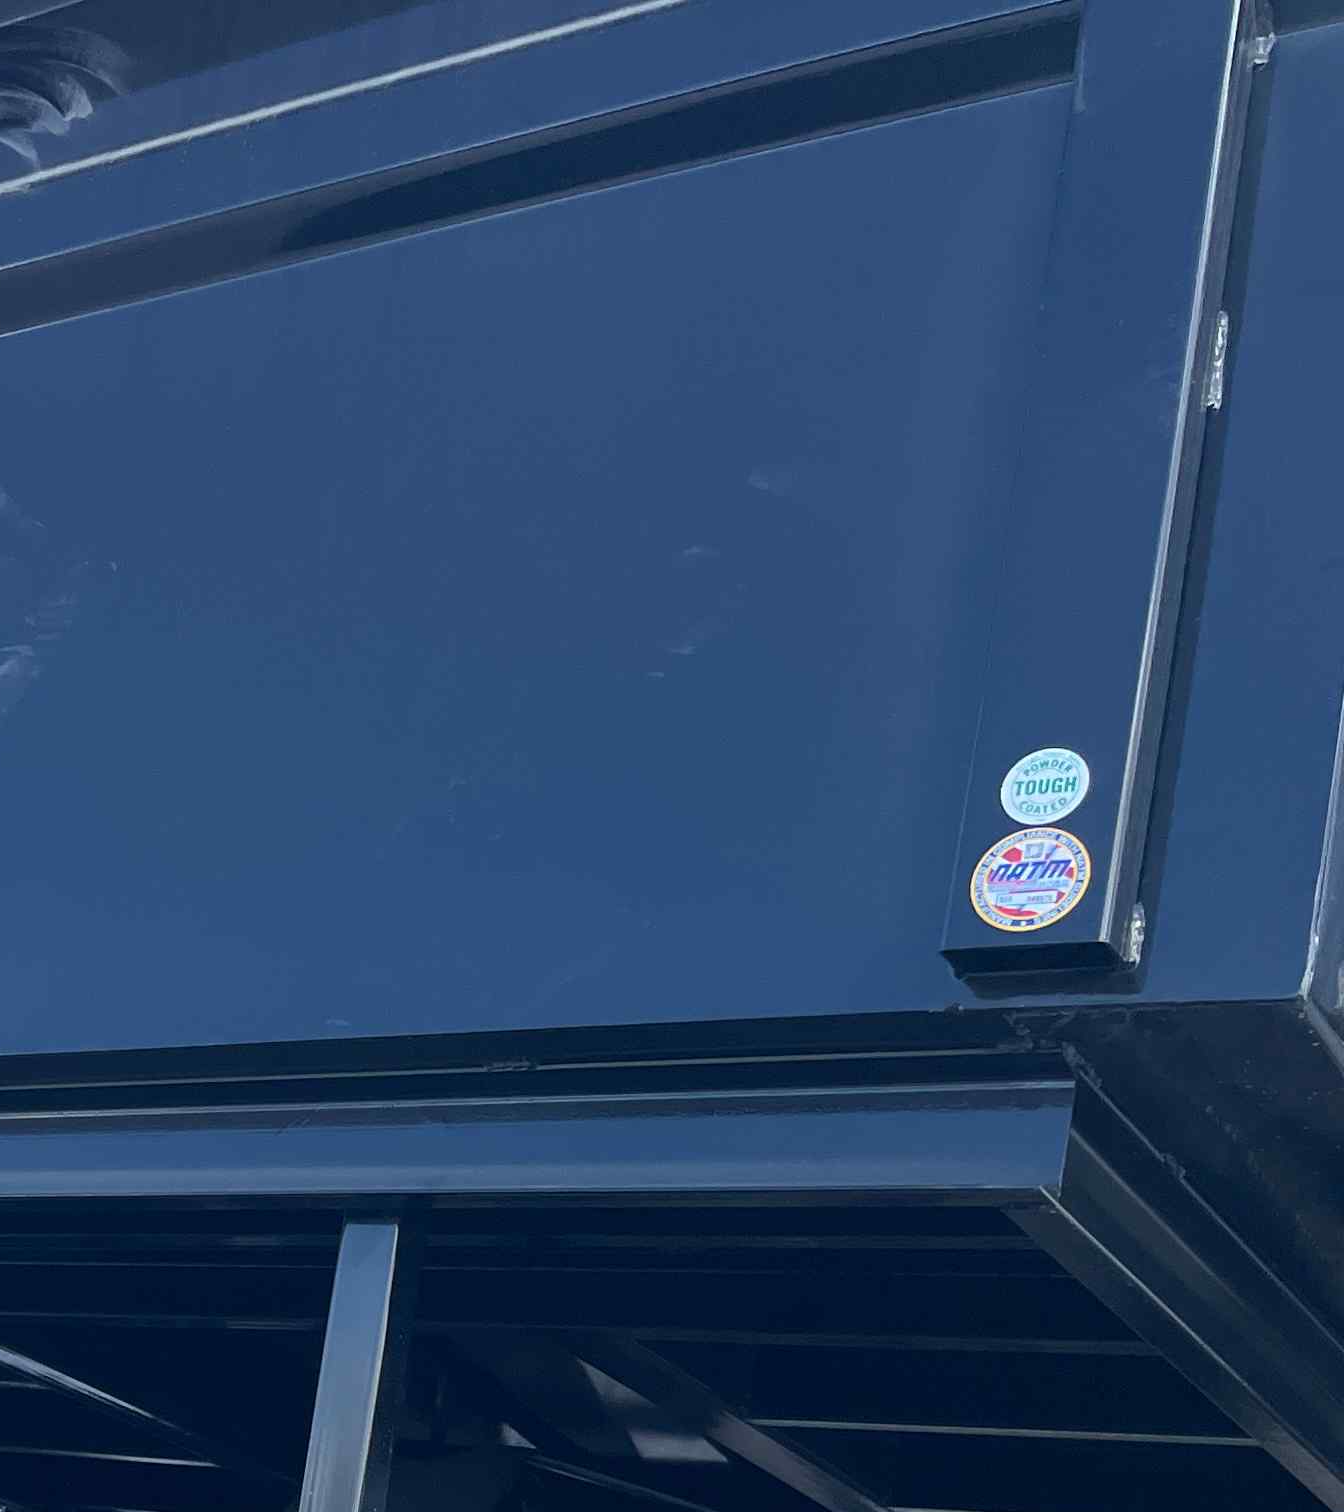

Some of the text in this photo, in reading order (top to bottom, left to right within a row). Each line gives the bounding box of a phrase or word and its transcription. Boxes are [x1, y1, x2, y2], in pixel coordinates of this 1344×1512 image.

[1023, 759, 1073, 777] POWDER
[1014, 776, 1078, 796] TOUGH
[1019, 796, 1068, 815] COATED
